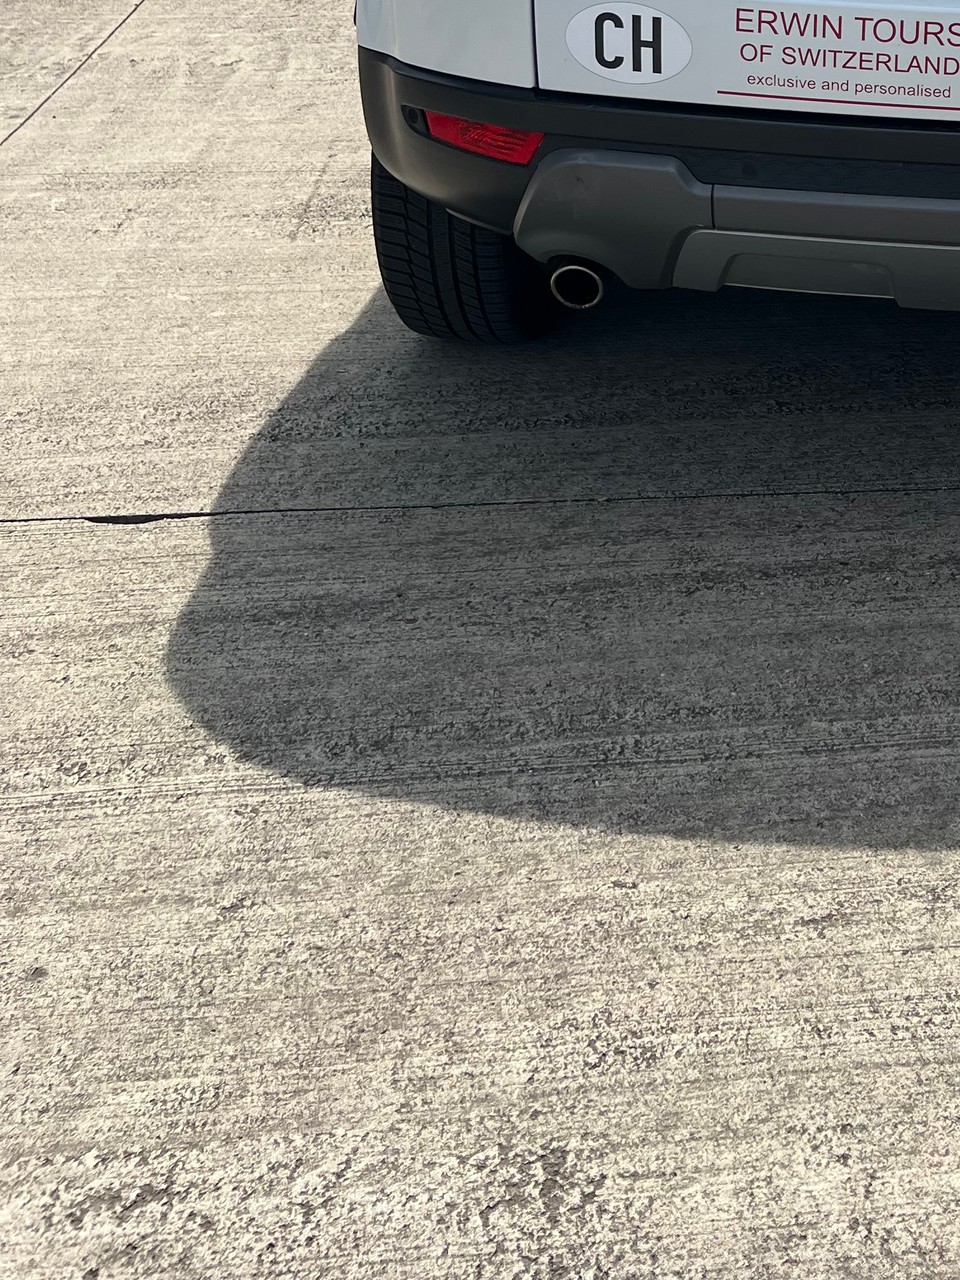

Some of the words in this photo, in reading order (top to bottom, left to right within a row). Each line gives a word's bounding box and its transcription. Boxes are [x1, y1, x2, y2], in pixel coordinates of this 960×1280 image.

[735, 7, 843, 40] ERWIN
[594, 11, 663, 74] CH
[739, 43, 774, 63] OF
[781, 46, 960, 76] SWITZERLAND
[746, 73, 817, 90] exclusive
[821, 79, 850, 93] and
[854, 80, 952, 99] personalised
